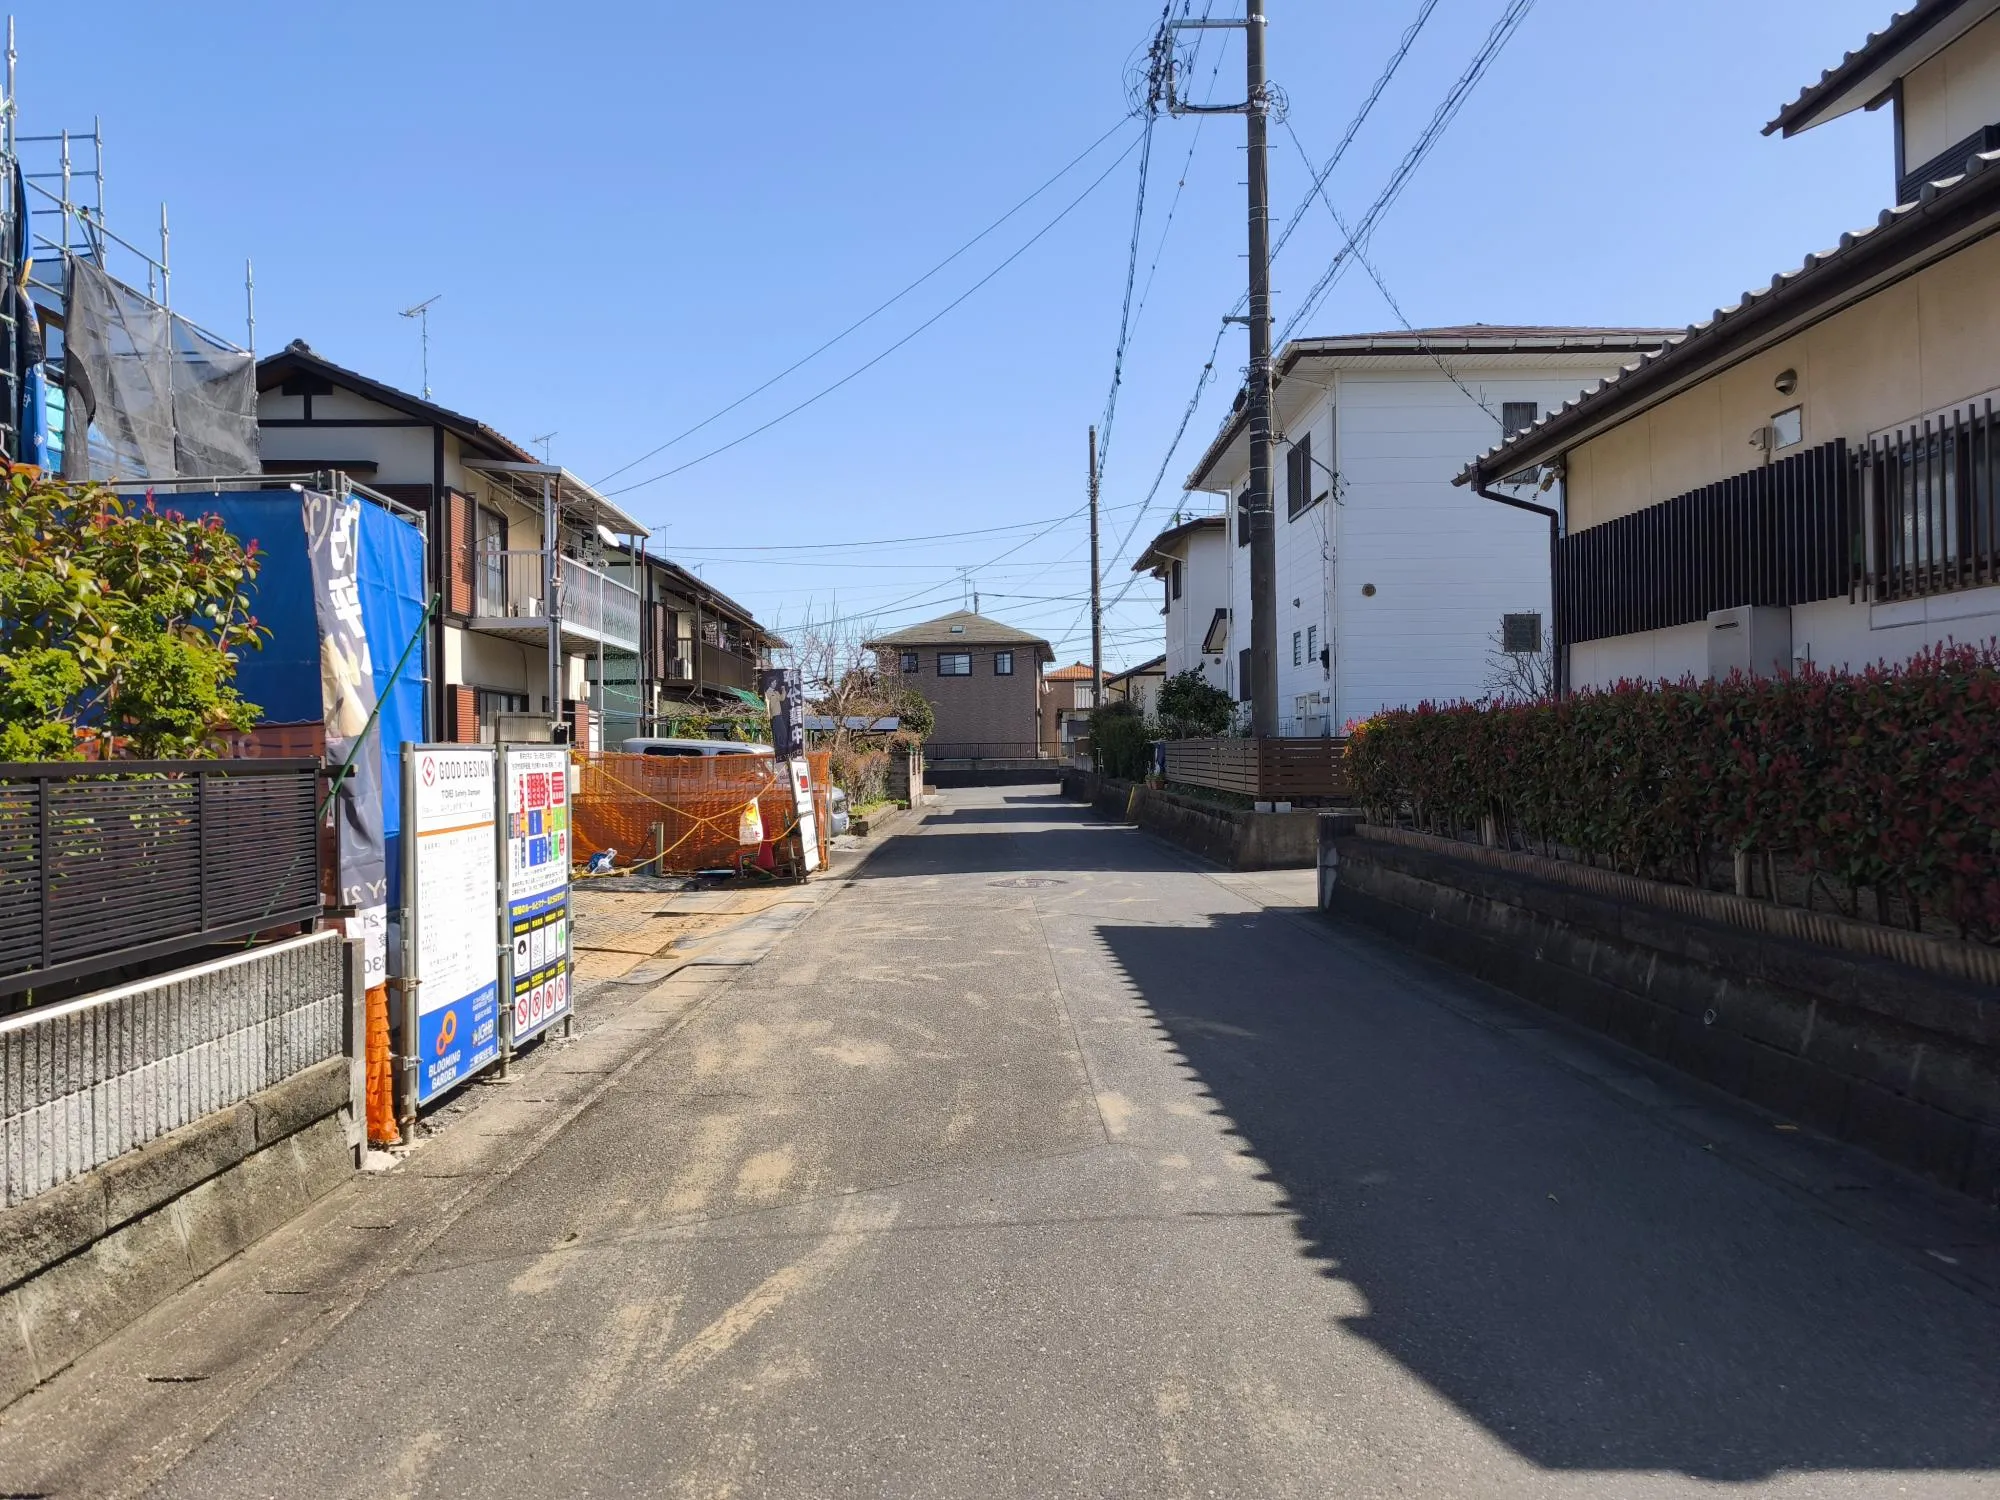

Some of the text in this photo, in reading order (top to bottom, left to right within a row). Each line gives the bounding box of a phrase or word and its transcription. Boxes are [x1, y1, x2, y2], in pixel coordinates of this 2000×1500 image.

[439, 760, 490, 780] GOOD DESIGN
[428, 1049, 461, 1078] BLOOMING
[431, 1065, 457, 1091] GARDEN
